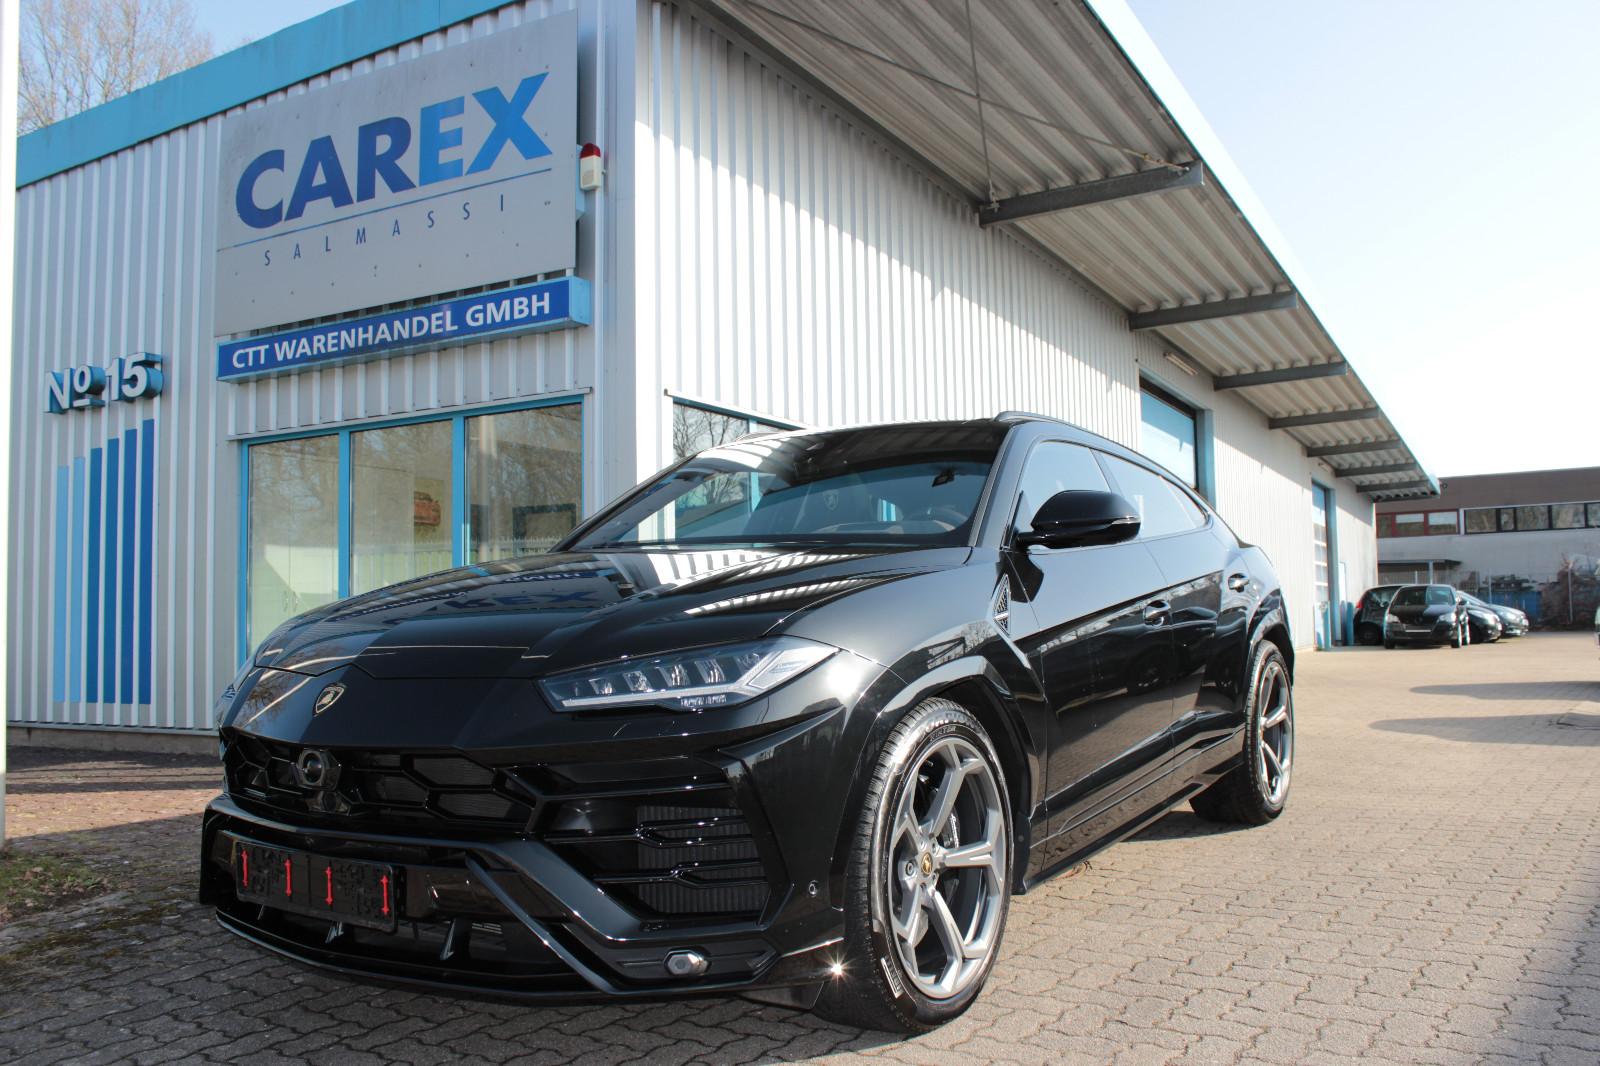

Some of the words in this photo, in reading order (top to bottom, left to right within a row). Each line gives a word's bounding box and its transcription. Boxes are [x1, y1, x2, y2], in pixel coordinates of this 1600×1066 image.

[235, 71, 553, 229] CAREX
[264, 194, 504, 266] SALMASSI
[232, 344, 269, 369] CTT
[274, 310, 458, 358] WARENHANDEL
[465, 291, 550, 327] GMBH
[105, 351, 149, 401] 15
